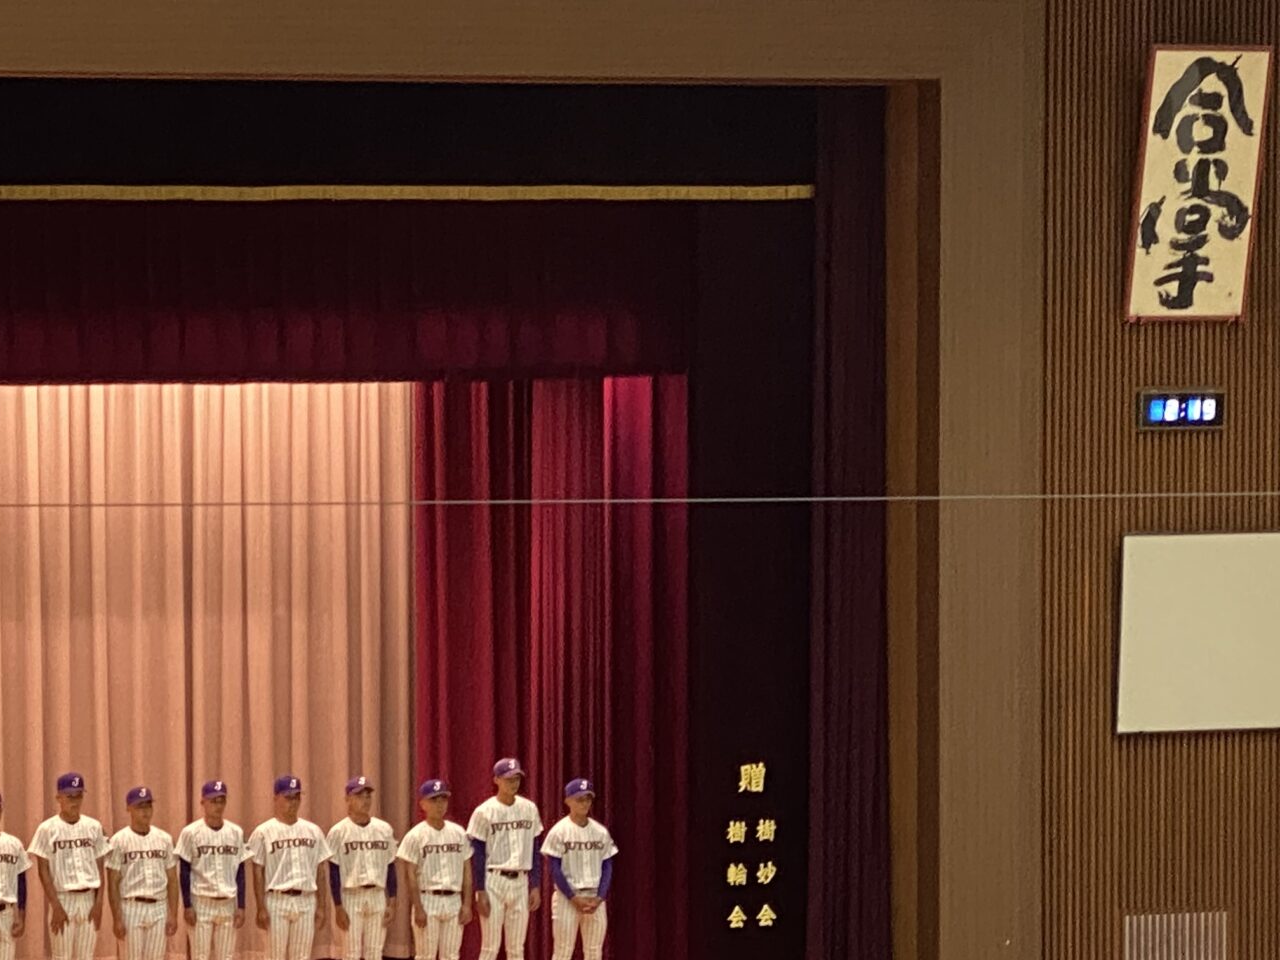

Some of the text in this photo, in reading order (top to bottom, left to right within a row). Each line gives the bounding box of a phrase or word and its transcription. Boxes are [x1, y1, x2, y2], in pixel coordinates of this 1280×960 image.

[738, 761, 766, 793] 贈
[490, 820, 533, 835] JUTOKU
[344, 841, 389, 854] JUTOKU
